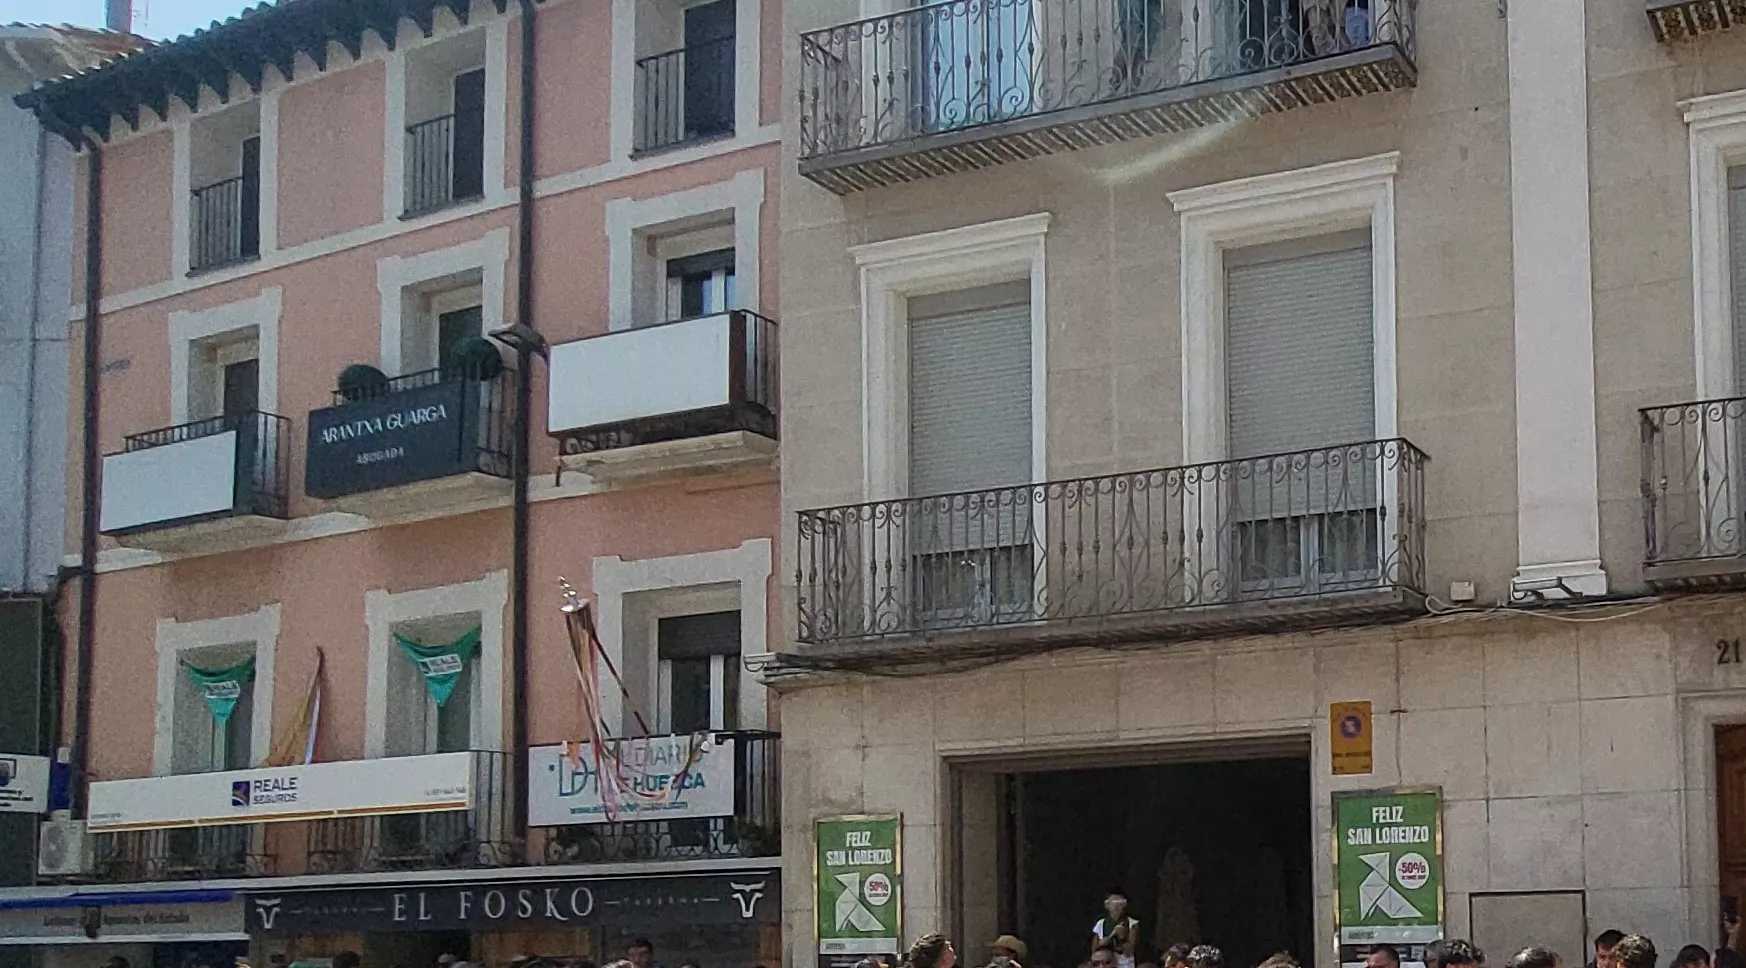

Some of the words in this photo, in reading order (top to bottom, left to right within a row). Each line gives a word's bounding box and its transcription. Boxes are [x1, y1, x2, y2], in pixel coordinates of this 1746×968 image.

[322, 418, 383, 444] ARANTXA
[386, 403, 447, 430] GUARGA
[1716, 638, 1742, 665] 21
[254, 777, 298, 792] REALE
[253, 792, 298, 805] SEGUROS
[1372, 806, 1404, 823] FELIZ
[846, 831, 871, 847] FELIZ
[1347, 828, 1372, 845] SAN
[1375, 826, 1429, 844] LORENZO
[826, 850, 846, 866] SAN
[848, 849, 892, 866] LORENZO
[392, 892, 432, 921] EL
[458, 886, 594, 921] FOSKO
